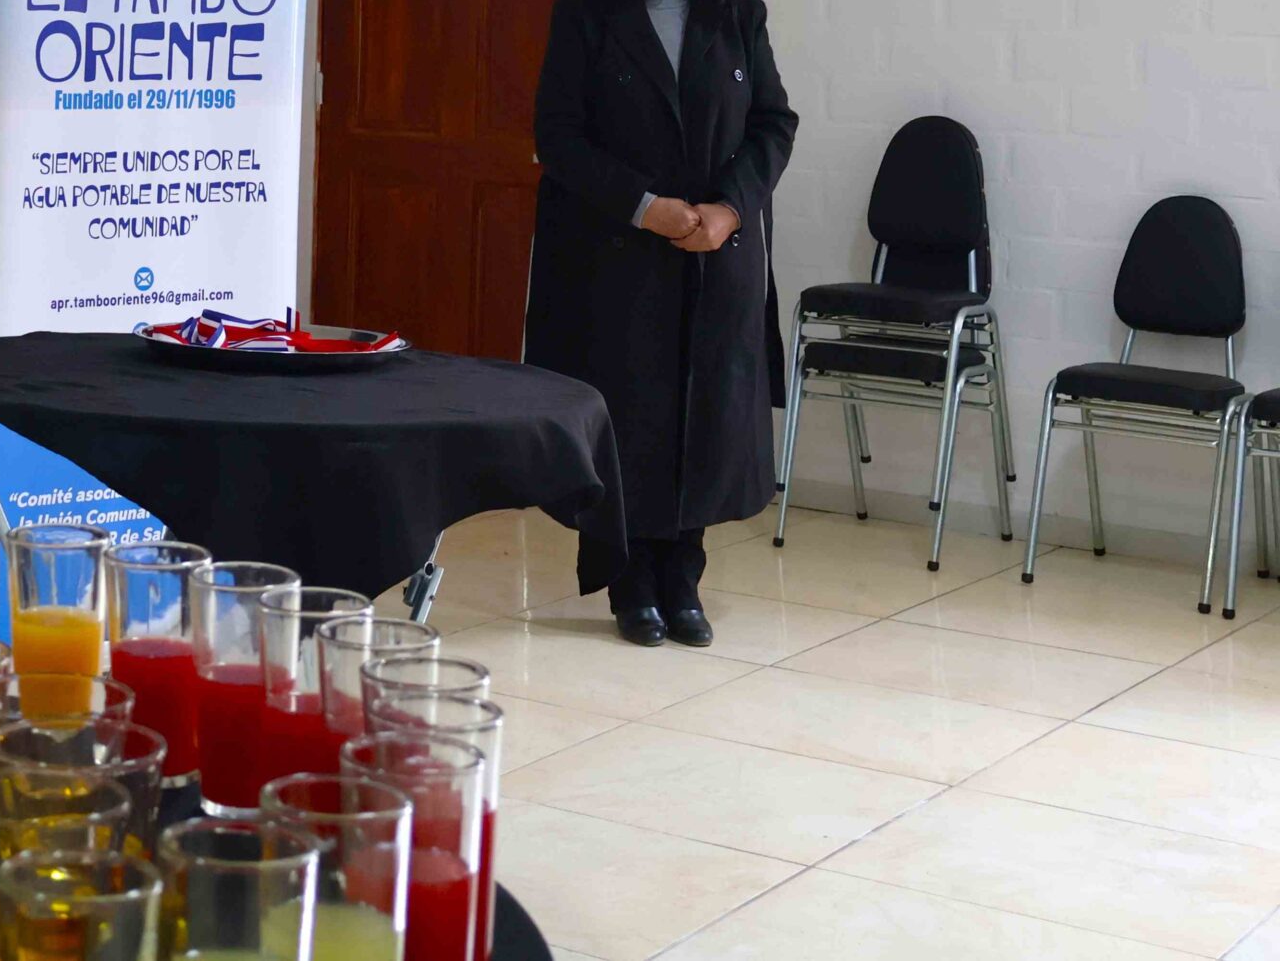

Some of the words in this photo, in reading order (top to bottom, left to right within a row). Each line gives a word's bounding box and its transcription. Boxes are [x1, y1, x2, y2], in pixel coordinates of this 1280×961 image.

[35, 20, 265, 82] ORIENTE
[54, 89, 124, 111] Fundado
[127, 89, 142, 110] el
[146, 88, 236, 109] 29/11/1996
[32, 151, 117, 175] “SIEMPRE
[122, 149, 190, 173] UNIDOS
[194, 149, 233, 171] POR
[237, 149, 261, 171] EL
[22, 185, 67, 209] AGUA
[72, 183, 152, 207] POTABLE
[156, 182, 181, 205] DE
[185, 181, 268, 204] NUESTRA
[88, 214, 199, 239] COMUNIDAD”
[50, 288, 234, 311] apr.tambooriente96@gmail.com
[120, 528, 139, 544] de
